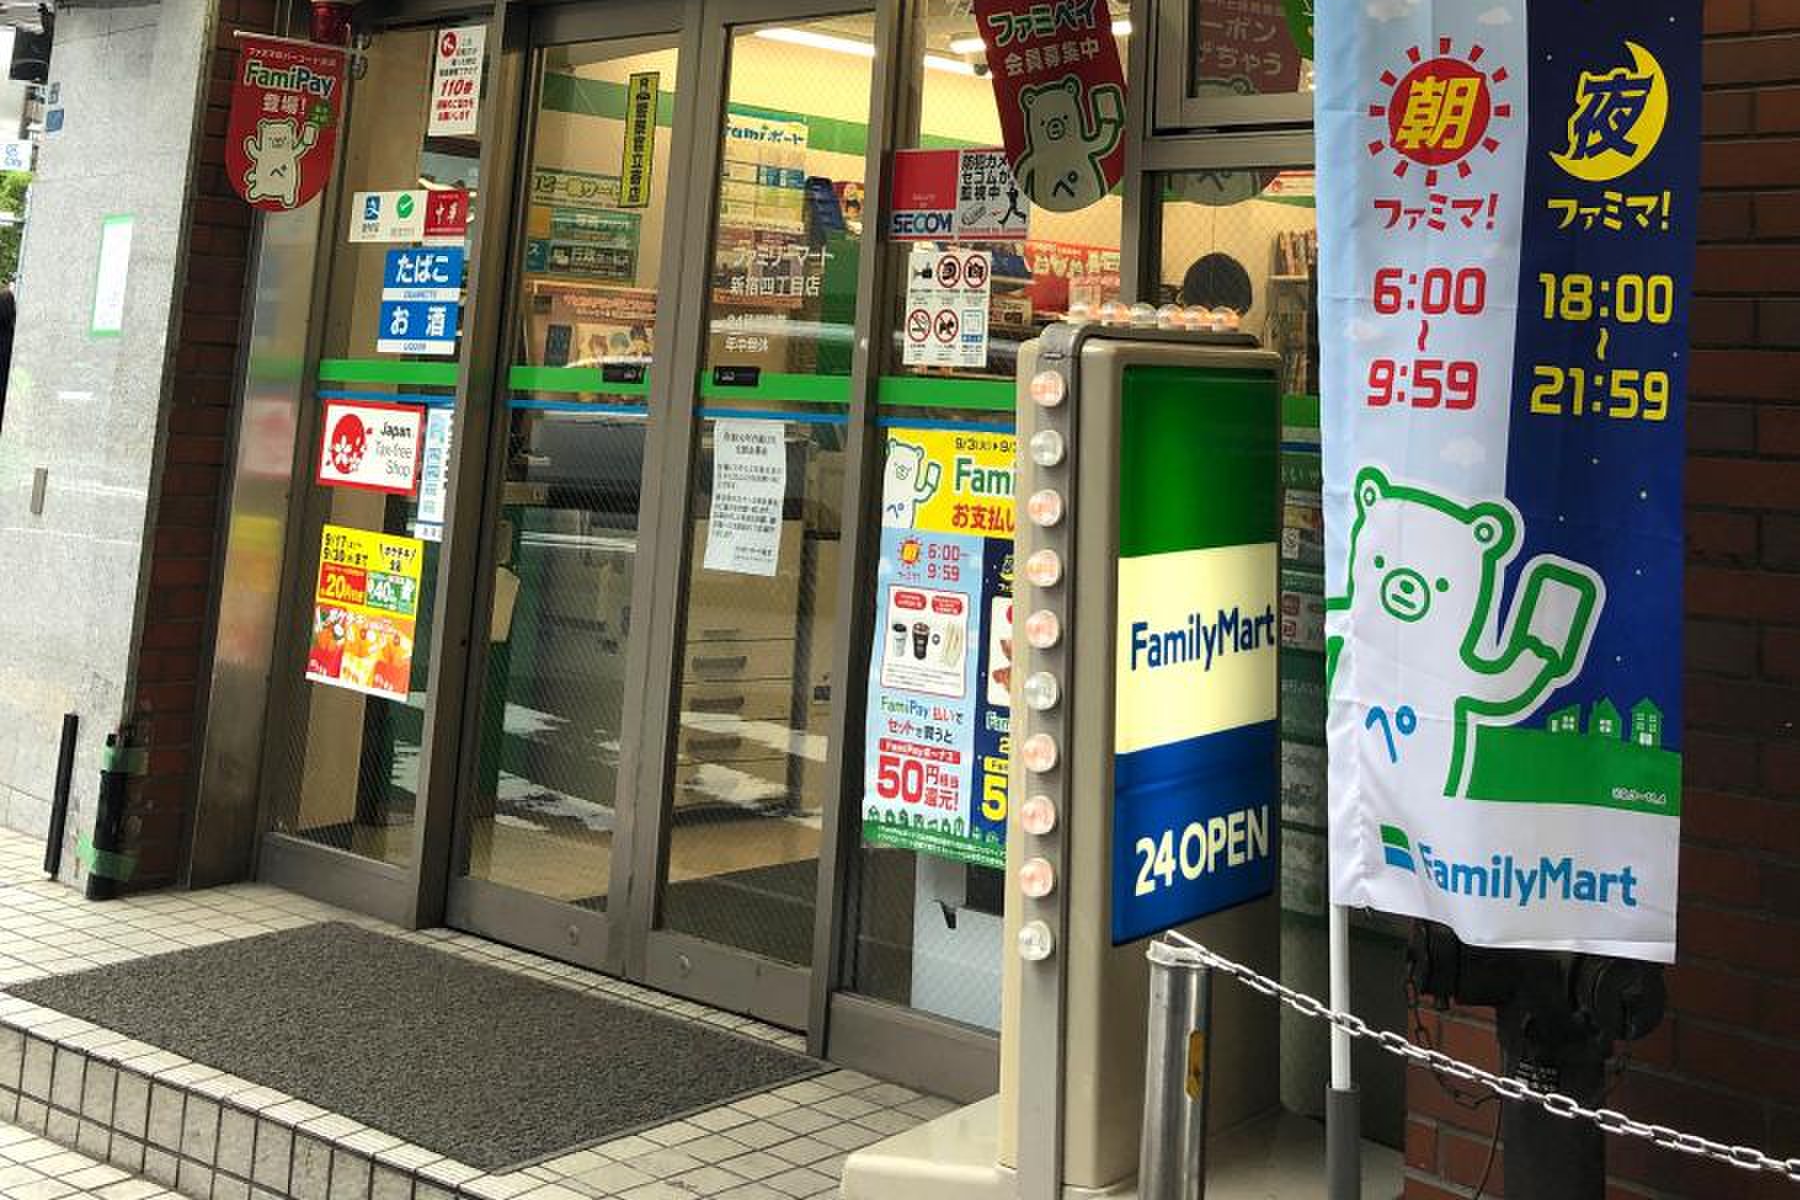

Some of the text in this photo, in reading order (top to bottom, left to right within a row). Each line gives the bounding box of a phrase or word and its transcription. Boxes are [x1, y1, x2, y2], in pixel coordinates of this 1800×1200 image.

[1004, 37, 1102, 77] 会員募集中
[244, 59, 336, 99] FamiPay
[1395, 74, 1481, 151] 朝
[1567, 66, 1656, 162] 夜
[960, 186, 1001, 201] 監視中
[1052, 172, 1079, 198] ペ
[893, 212, 953, 234] SECOM
[1373, 193, 1498, 232] ファミマ!
[1546, 191, 1673, 232] ファミマ!
[395, 254, 450, 285] たばこ
[733, 244, 834, 270] ファミリーマート
[729, 275, 822, 298] 新宿四丁目店
[1372, 267, 1487, 316] 6:00
[1538, 272, 1675, 323] 18:00
[389, 304, 447, 337] お酒
[1365, 358, 1479, 410] 9:59
[1530, 366, 1671, 422] 21:59
[375, 440, 413, 460] Tax-free
[385, 459, 411, 480] Shop
[927, 563, 961, 582] 9:59
[1130, 603, 1275, 672] FamilyMart
[880, 696, 929, 721] FamiPay
[887, 718, 955, 745] セットで買うと
[876, 754, 924, 805] 50
[1418, 840, 1638, 907] FamilyMart
